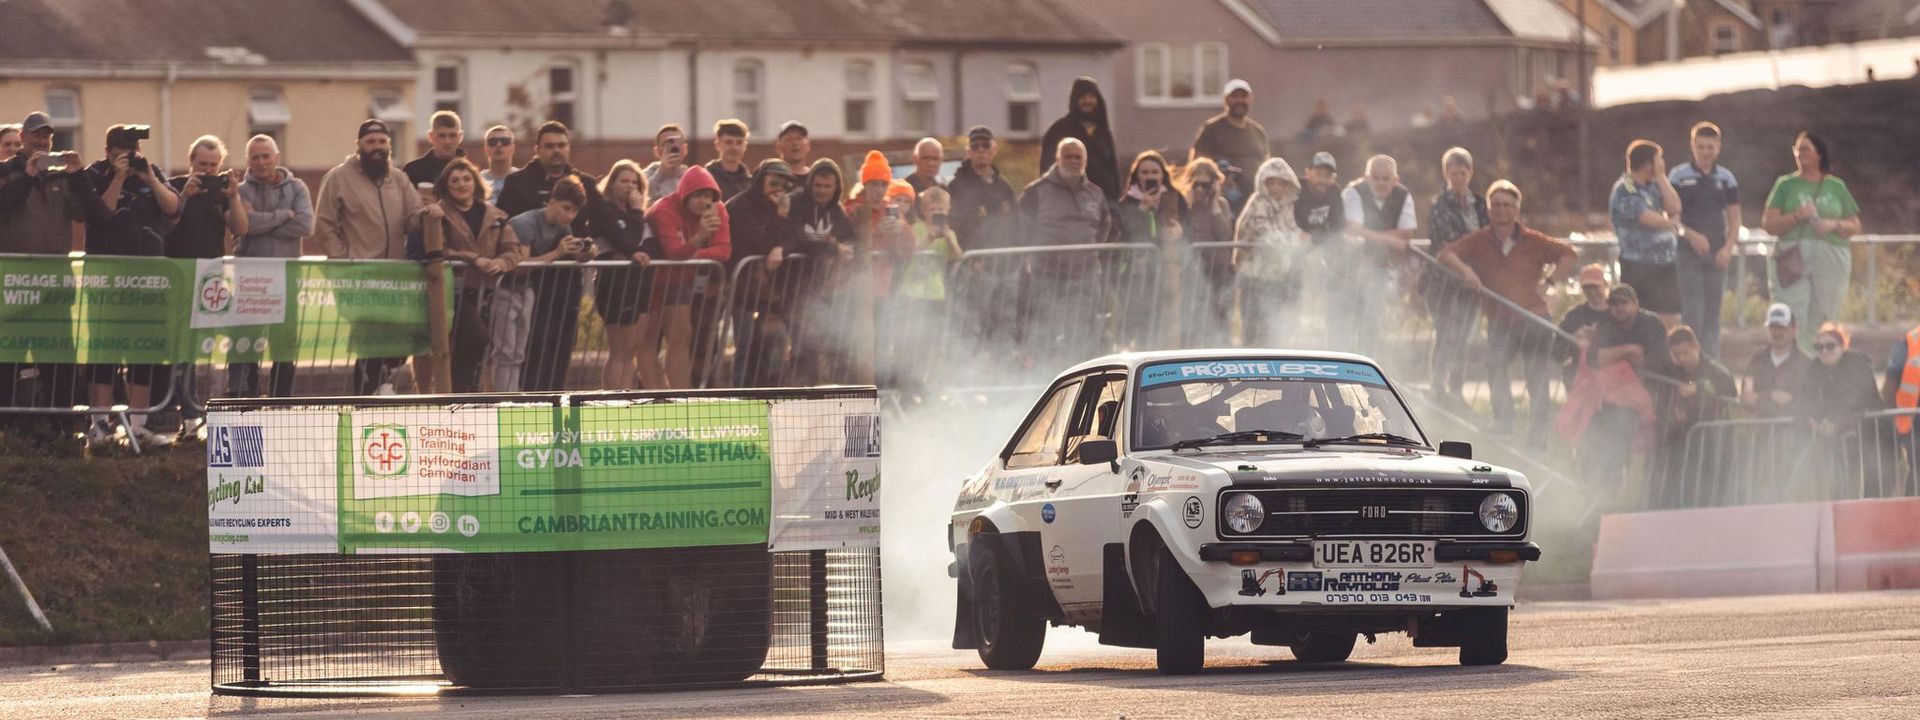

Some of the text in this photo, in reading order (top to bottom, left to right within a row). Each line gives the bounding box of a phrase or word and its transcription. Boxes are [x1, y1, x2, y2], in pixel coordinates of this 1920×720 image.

[4, 274, 172, 289] ENGAGE. INSPIRE. SUCCEED.
[4, 290, 40, 304] WITH
[297, 291, 336, 306] GYDA
[1181, 363, 1270, 377] PROBITE
[419, 426, 475, 441] Cambrian
[515, 424, 762, 444] YMGYSYLLTU. YSBRYDOLI. LLWYDDO.
[420, 438, 465, 454] Training
[419, 455, 491, 471] Hyfforddiant
[517, 442, 761, 469] GYDA PRENTISIAETHAU.
[419, 467, 476, 482] Cambrian
[245, 475, 263, 495] Ltd
[825, 511, 836, 519] MID
[845, 510, 858, 518] WEST
[1362, 506, 1386, 518] FORD
[226, 519, 255, 527] RECYCLING
[258, 518, 291, 527] EXPERTS
[517, 508, 764, 534] CAMBRIANTRAINING.COM
[1323, 543, 1425, 563] UEA 826R
[1340, 572, 1401, 582] ANTHONY
[1326, 594, 1364, 602] 07970
[1370, 594, 1390, 602] 013
[1395, 593, 1417, 602] 043
